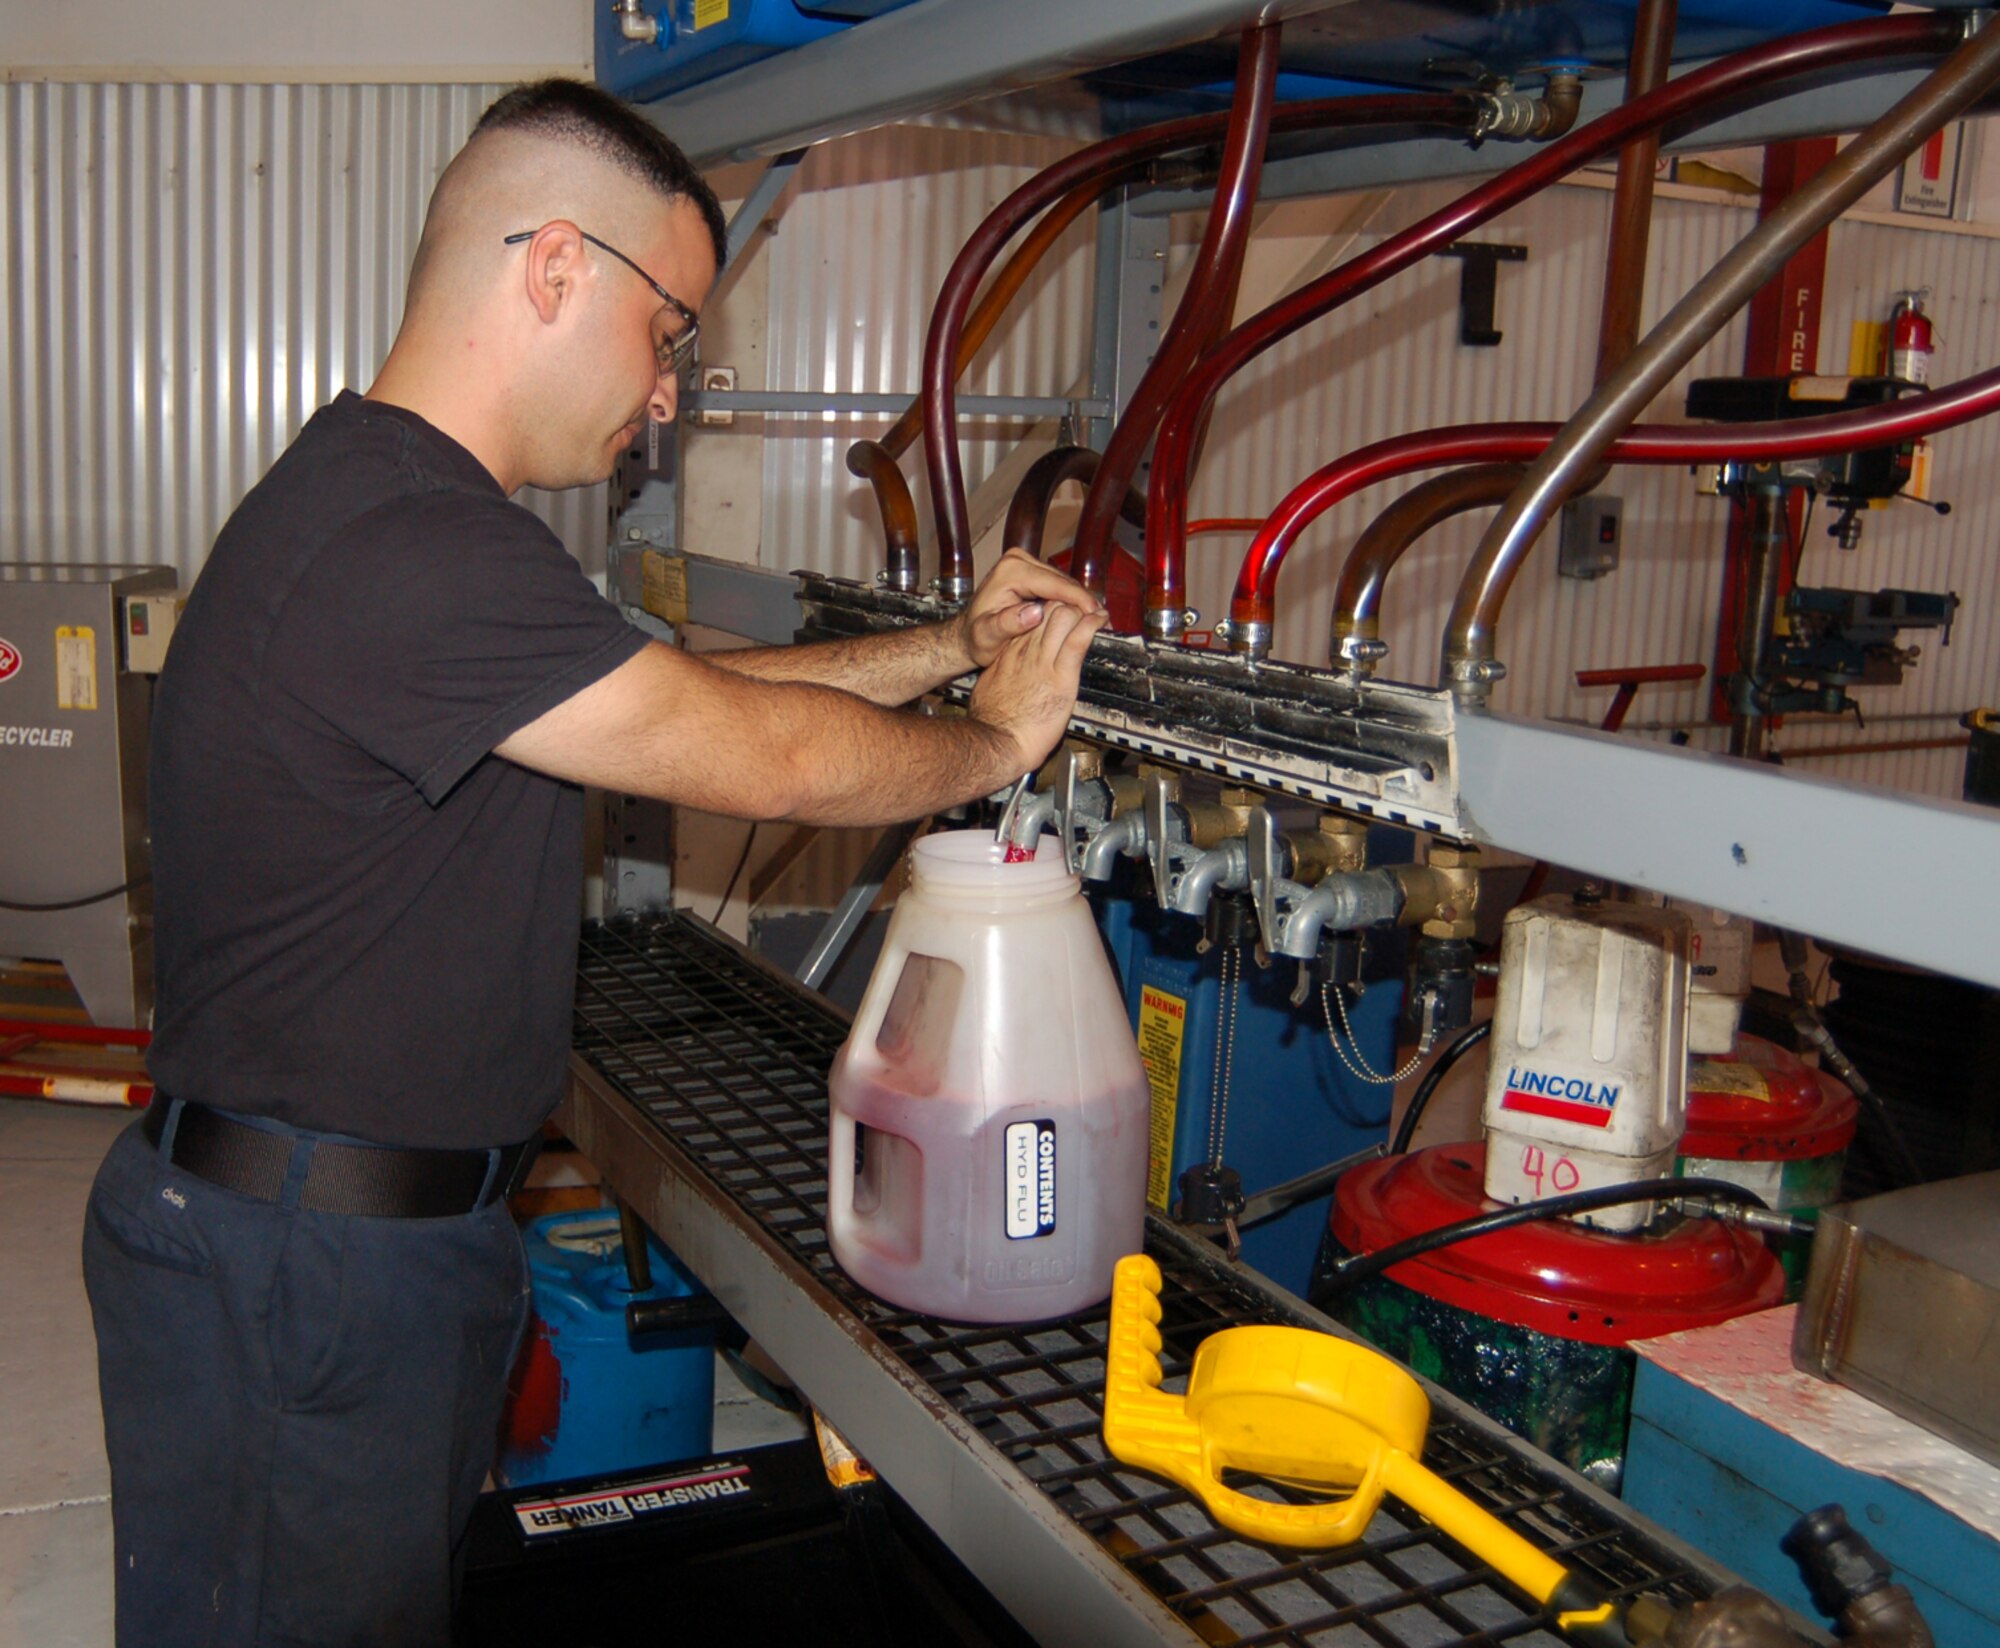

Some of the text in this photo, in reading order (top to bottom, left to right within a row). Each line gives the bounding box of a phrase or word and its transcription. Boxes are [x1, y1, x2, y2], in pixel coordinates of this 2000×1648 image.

[1790, 288, 1809, 372] FIRE
[1143, 991, 1184, 1019] WARNING
[1506, 1067, 1619, 1108] LINCOLN
[1017, 1135, 1028, 1223] HYD FLU
[1039, 1130, 1054, 1226] CONTENTS
[1523, 1144, 1580, 1197] 40
[530, 1497, 625, 1527] TANKER
[628, 1476, 751, 1512] TRANSFER
